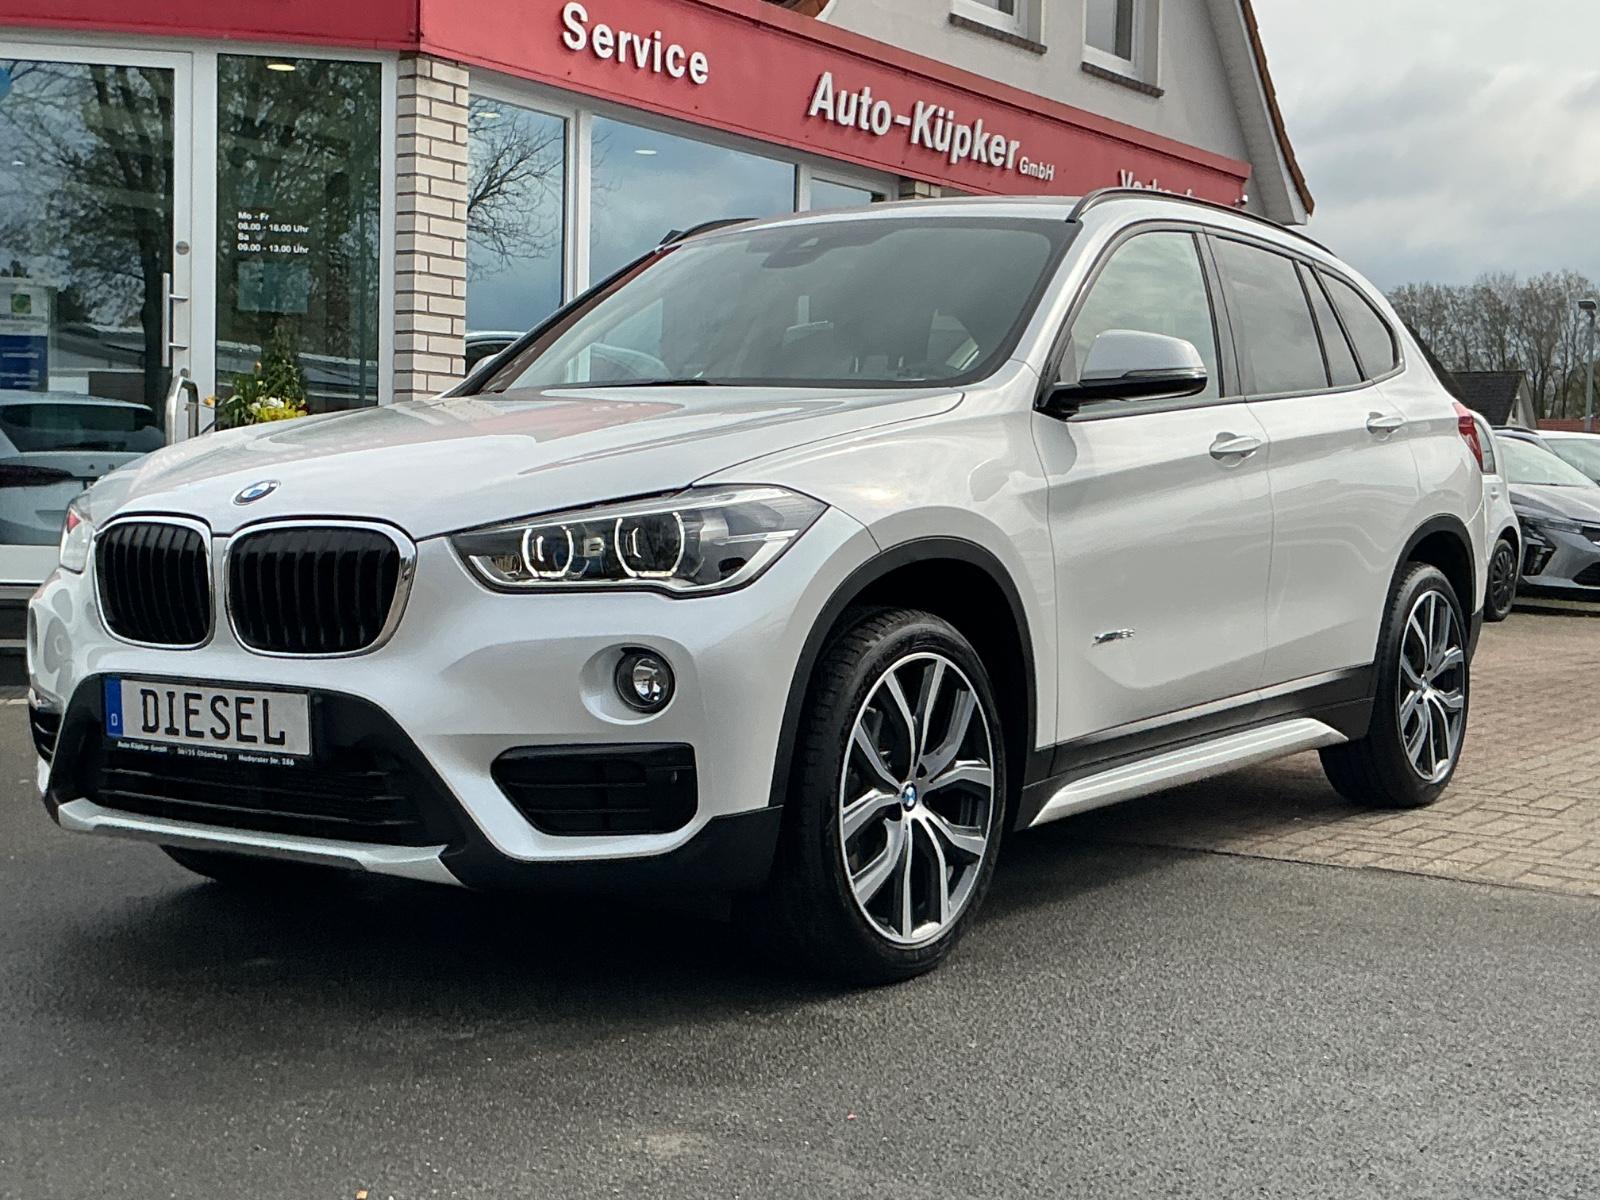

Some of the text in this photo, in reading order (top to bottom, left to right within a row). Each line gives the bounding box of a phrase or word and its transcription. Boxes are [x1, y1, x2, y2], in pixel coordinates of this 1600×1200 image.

[562, 1, 709, 85] Service
[808, 71, 1055, 181] Auto-Küpker GmbH
[238, 212, 252, 220] Mo
[260, 212, 269, 220] Fr
[293, 225, 309, 233] Uhr
[237, 232, 250, 240] Sa
[293, 245, 309, 253] Uhr
[140, 688, 286, 746] DIESEL
